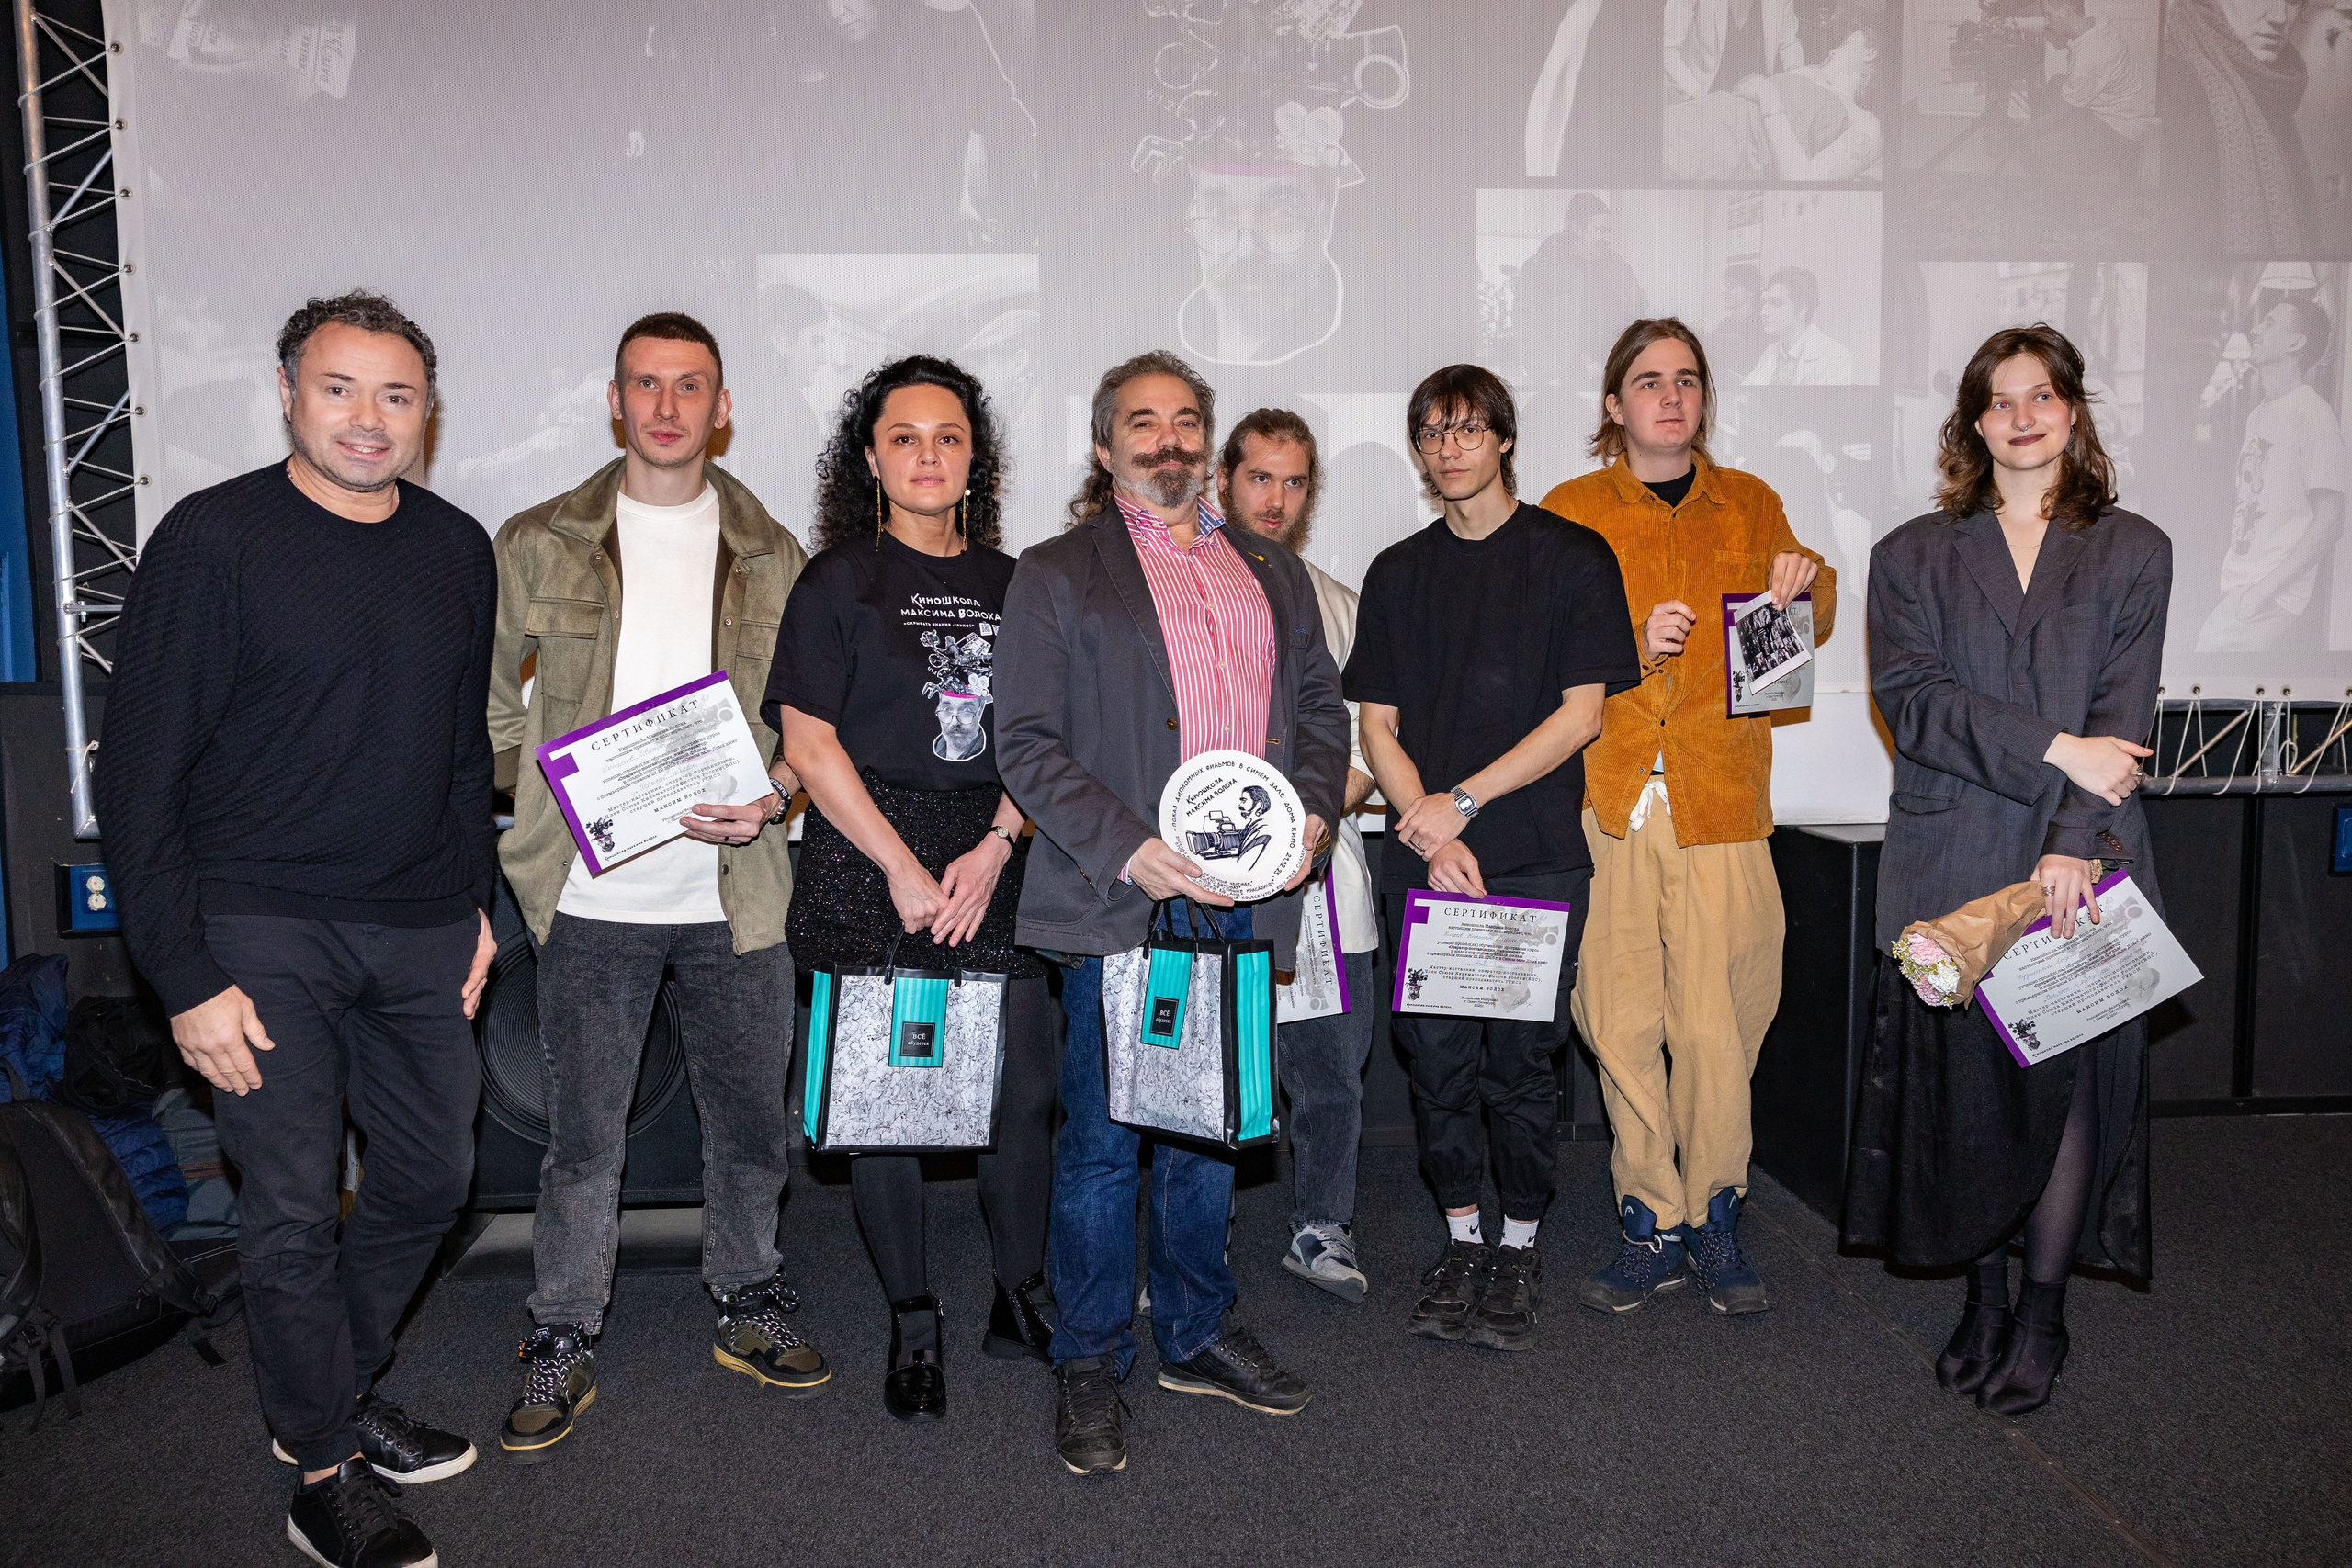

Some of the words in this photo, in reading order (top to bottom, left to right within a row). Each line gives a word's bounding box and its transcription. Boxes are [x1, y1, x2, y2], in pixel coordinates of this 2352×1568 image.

[901, 609, 956, 619] МАКСИМА
[958, 609, 1001, 621] ВОЛОХА
[591, 699, 698, 751] СЕРТИФИКАТ
[654, 797, 681, 813] МАКСИМ
[684, 787, 706, 799] ВОЛОХ
[1175, 767, 1204, 803] ДИПЛОМНЫХ
[1205, 761, 1235, 771] ФИЛЬМОВ
[1246, 766, 1269, 782] СИНЕМ
[1269, 782, 1286, 799] ЗАЛЕ
[1284, 802, 1295, 823] ДОМА
[1186, 777, 1223, 805] КИНОШКОЛА
[1186, 795, 1215, 817] МАКСИМА
[1213, 778, 1238, 796] ВОЛОХА
[1444, 907, 1537, 923] СЕРТИФИКАТ
[1313, 895, 1333, 985] СЕРТИФИКАТ
[2076, 997, 2104, 1014] МАКСИМ
[2105, 984, 2128, 998] ВОЛОХ
